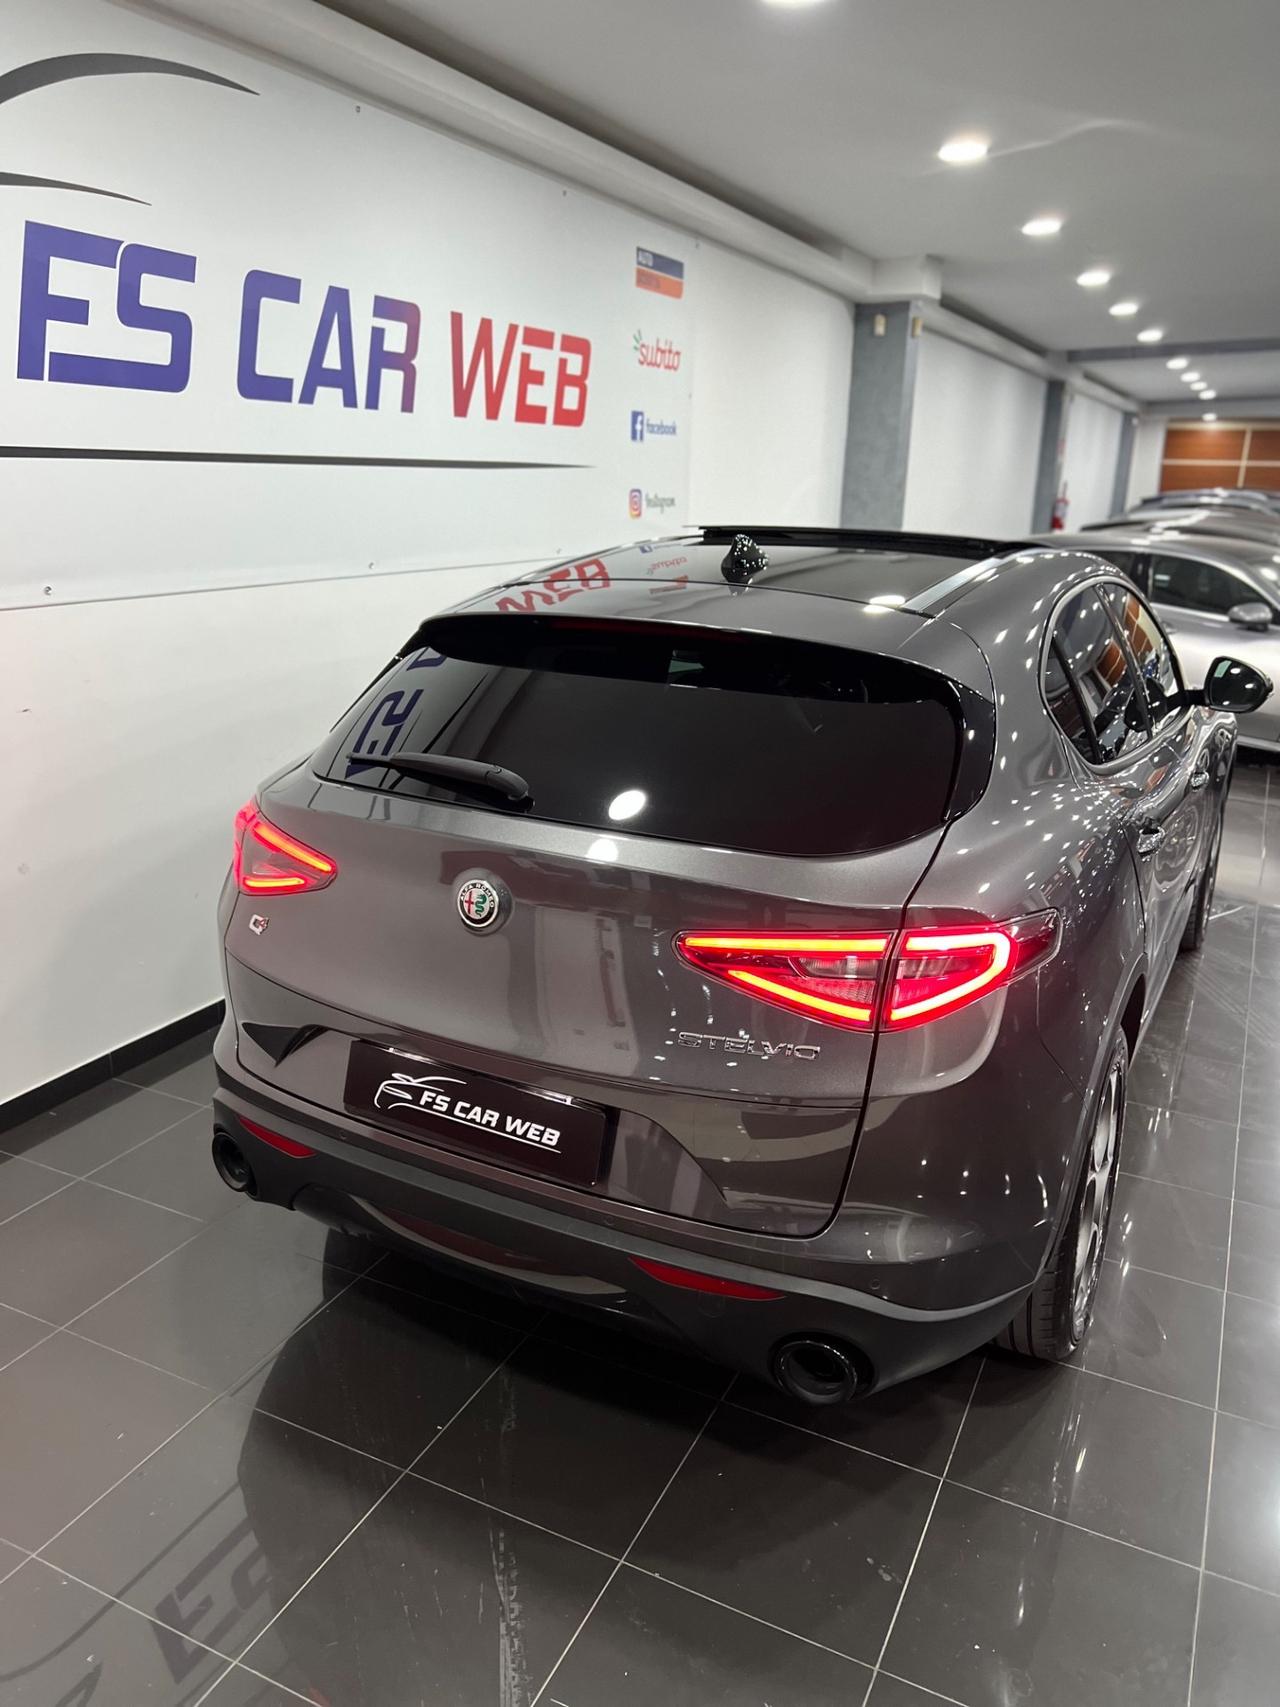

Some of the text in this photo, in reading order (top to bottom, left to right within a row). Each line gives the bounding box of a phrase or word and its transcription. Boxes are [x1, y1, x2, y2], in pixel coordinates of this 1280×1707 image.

[17, 220, 592, 428] FS CAR WEB
[638, 339, 680, 371] subito
[678, 1032, 820, 1060] STELVIO
[419, 1090, 561, 1147] FS CAR WEB
